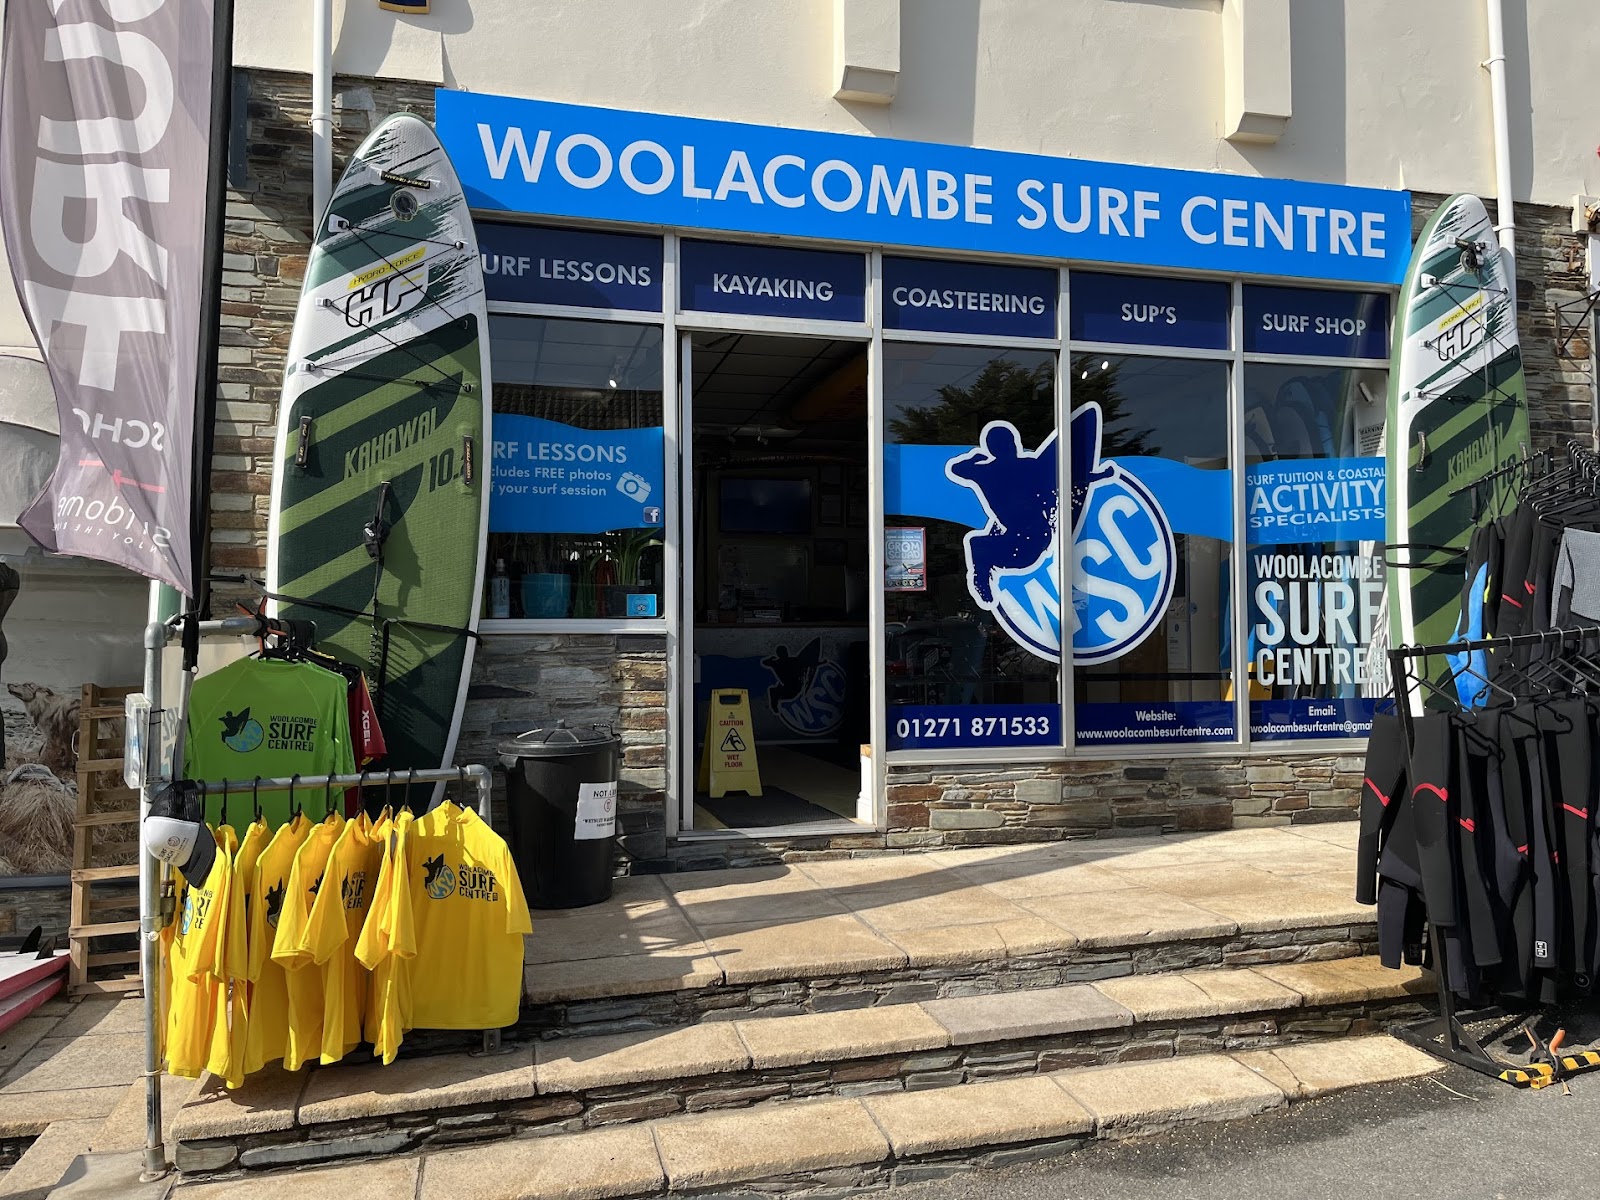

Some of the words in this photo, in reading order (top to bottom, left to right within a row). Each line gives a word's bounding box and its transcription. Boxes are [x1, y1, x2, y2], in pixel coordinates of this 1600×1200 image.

[477, 123, 993, 225] WOOLACOMBE
[1016, 179, 1160, 238] SURF
[1180, 195, 1386, 259] CENTRE
[353, 252, 420, 285] HYDRO-FORCE
[481, 254, 530, 276] URF
[539, 258, 651, 287] LESSONS
[713, 273, 834, 302] KAYAKING
[892, 286, 1046, 315] COASTEERING
[1262, 313, 1310, 334] SURF
[1315, 317, 1367, 337] SHOP
[343, 407, 438, 480] KAHAWAI
[493, 441, 519, 459] RF
[527, 442, 627, 464] LESSONS
[1447, 421, 1503, 482] KAHAWAI
[429, 448, 464, 493] 10.
[534, 467, 565, 479] FREE
[569, 468, 612, 482] photos
[1247, 472, 1275, 486] SURF
[1277, 470, 1324, 484] TUITION
[1326, 471, 1334, 480] &
[1338, 466, 1386, 480] COASTAL
[498, 484, 528, 496] your
[532, 483, 557, 494] surf
[560, 485, 607, 496] session
[1250, 479, 1384, 514] ACTIVITY
[1250, 508, 1386, 528] SPECIALISTS
[888, 541, 920, 552] GROM
[888, 550, 920, 560] SQUAD
[1254, 554, 1383, 580] WOOLACOMBE
[1254, 581, 1384, 645] SURF
[1256, 648, 1368, 686] CENTRE
[270, 715, 318, 726] WOOLACOMBE
[1135, 710, 1177, 722] Website:
[1308, 705, 1336, 718] Email:
[268, 722, 317, 741] SURF
[362, 709, 372, 747] XCEL
[896, 717, 961, 738] 01271
[970, 716, 1050, 738] 871533
[1076, 726, 1234, 740] www.woolacombesurfcentre.com
[1250, 720, 1373, 734] woolacombesurfcentre@gmai
[268, 740, 308, 751] CENTRE
[593, 790, 607, 798] NOT
[460, 870, 497, 892] SURF
[459, 886, 492, 902] CENTRE
